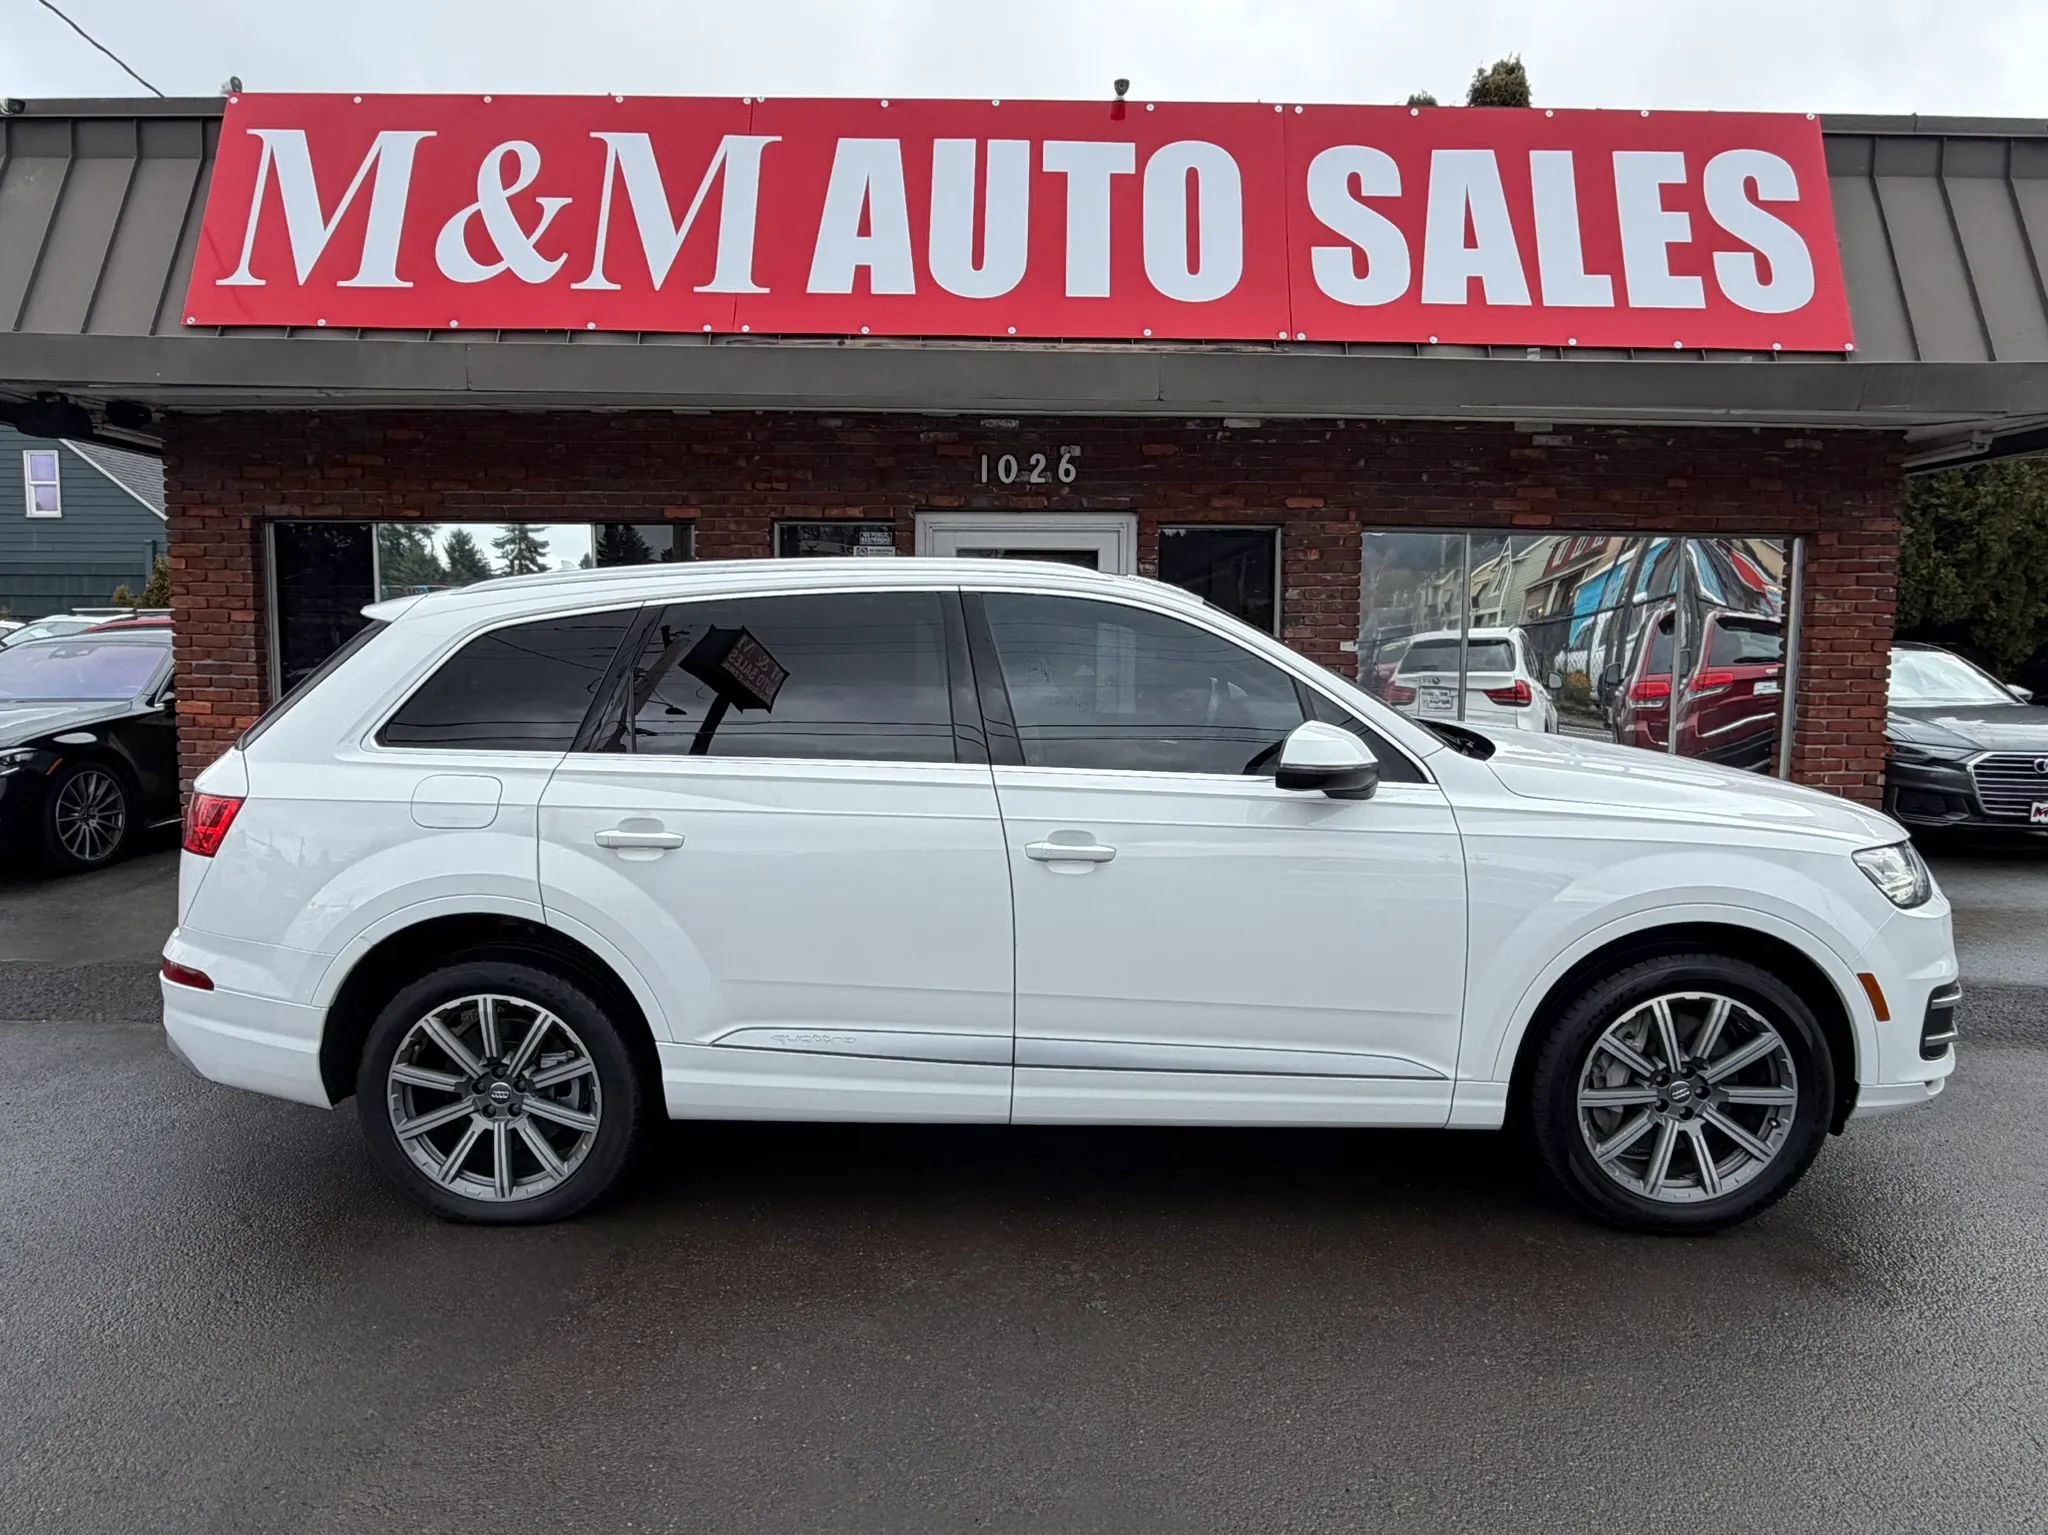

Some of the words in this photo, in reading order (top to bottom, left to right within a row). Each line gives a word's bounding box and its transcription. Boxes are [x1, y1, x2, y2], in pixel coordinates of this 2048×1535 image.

[215, 128, 783, 294] M&M
[806, 137, 1244, 302] AUTO
[1306, 145, 1815, 314] SALES
[981, 453, 1077, 484] 1026
[770, 1033, 857, 1044] quattro
